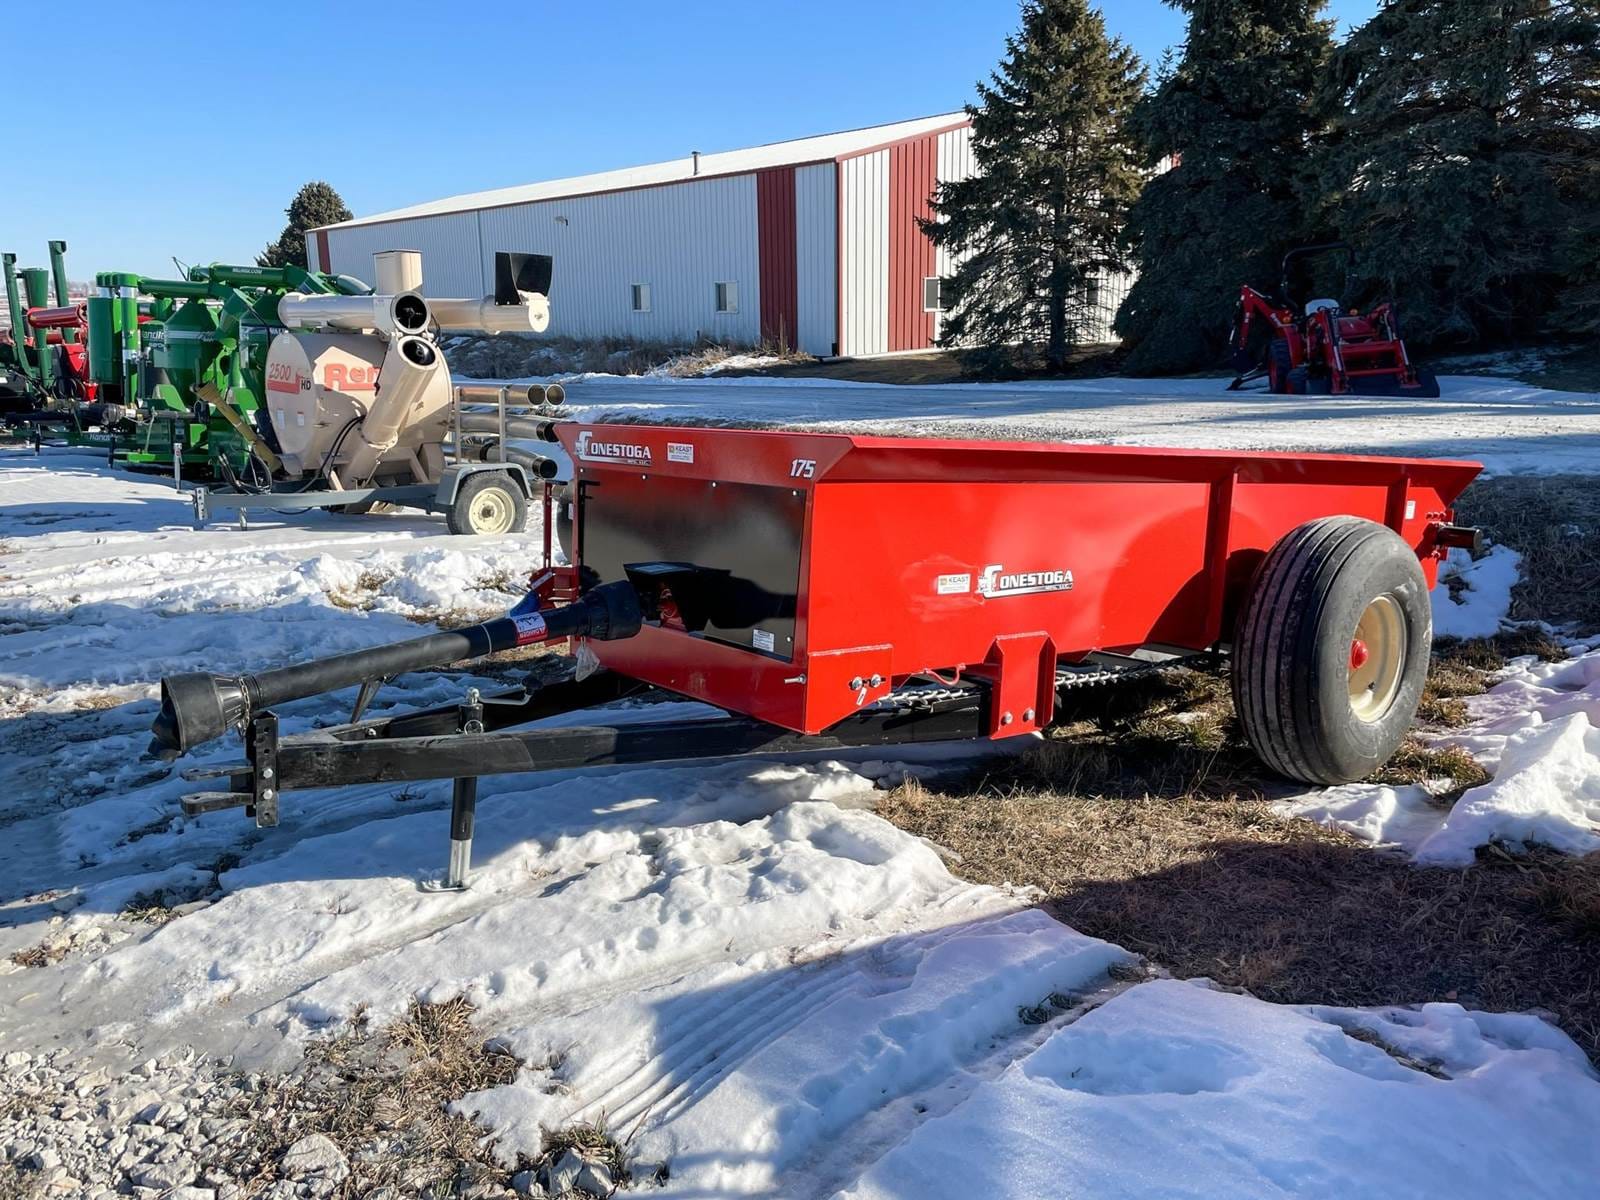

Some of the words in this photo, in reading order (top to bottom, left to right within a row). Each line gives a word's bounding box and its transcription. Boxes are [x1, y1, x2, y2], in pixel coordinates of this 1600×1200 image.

[269, 363, 291, 380] 2500
[300, 380, 312, 390] HD
[575, 431, 652, 461] CONESTOGA
[790, 459, 816, 478] 175
[977, 565, 1073, 598] CONESTOGA
